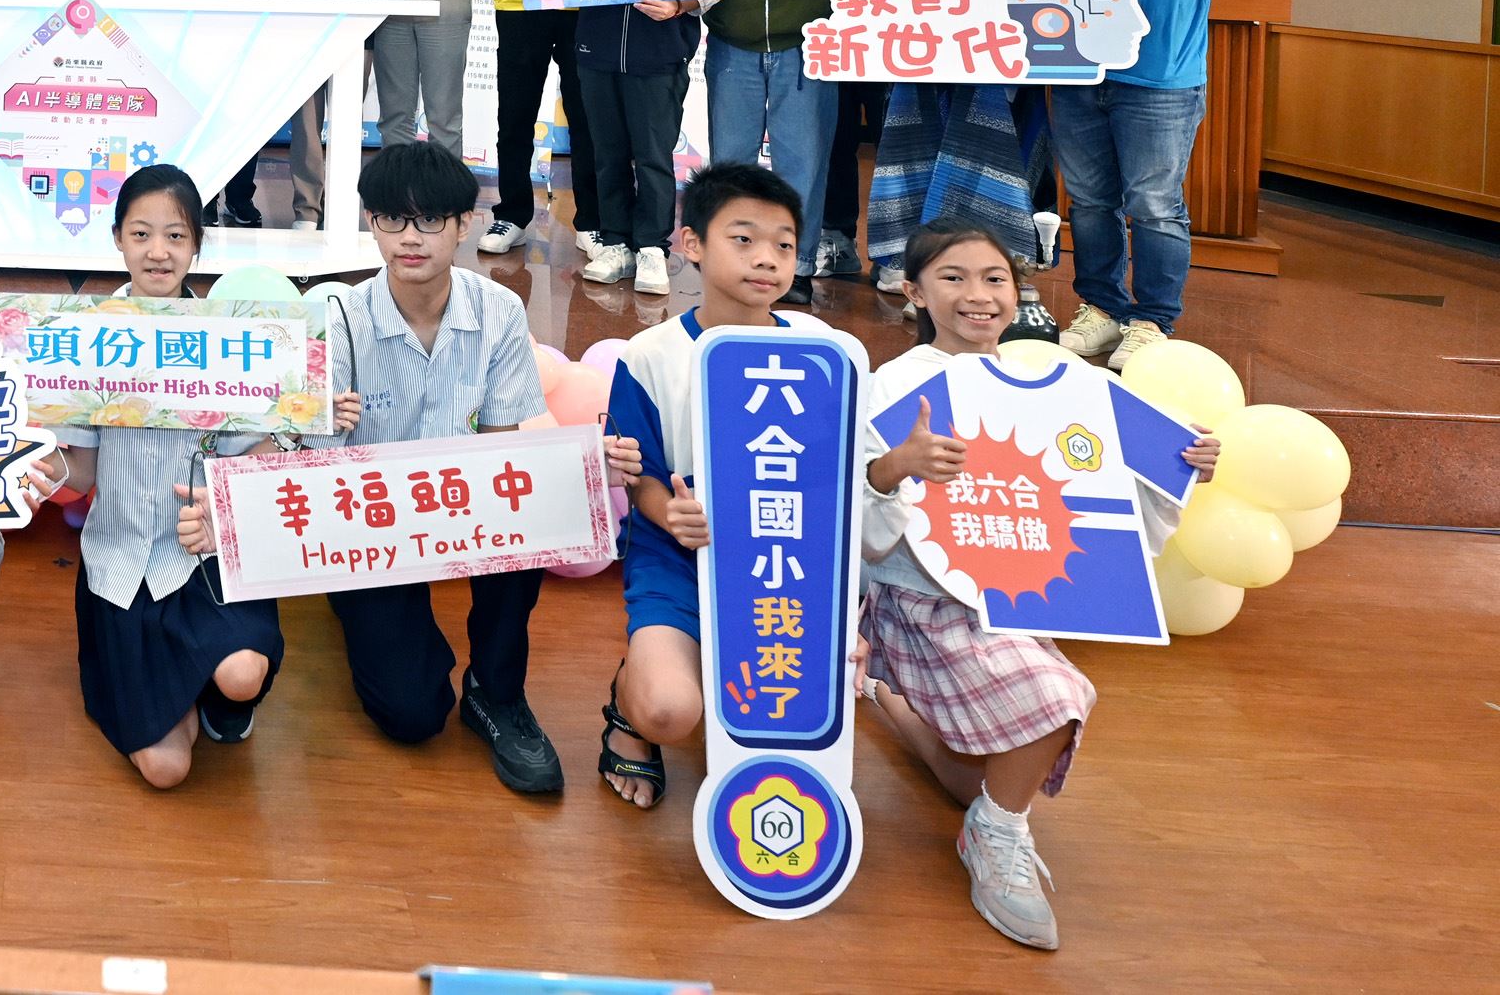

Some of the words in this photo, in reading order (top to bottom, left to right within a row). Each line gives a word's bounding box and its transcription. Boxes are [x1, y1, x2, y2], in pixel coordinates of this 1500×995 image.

[807, 21, 1024, 79] 新世代
[15, 91, 145, 112] AI半導體營隊
[25, 325, 273, 372] 頭份國中
[25, 373, 89, 392] Toufen
[95, 377, 159, 394] Junior
[164, 378, 210, 399] High
[215, 380, 281, 399] School
[275, 461, 533, 537] 幸福頭中
[945, 472, 1041, 510] 我六合
[302, 542, 397, 573] Happy
[410, 524, 524, 558] Toufen
[950, 512, 1051, 552] 我驕傲
[756, 850, 800, 866] 六合
